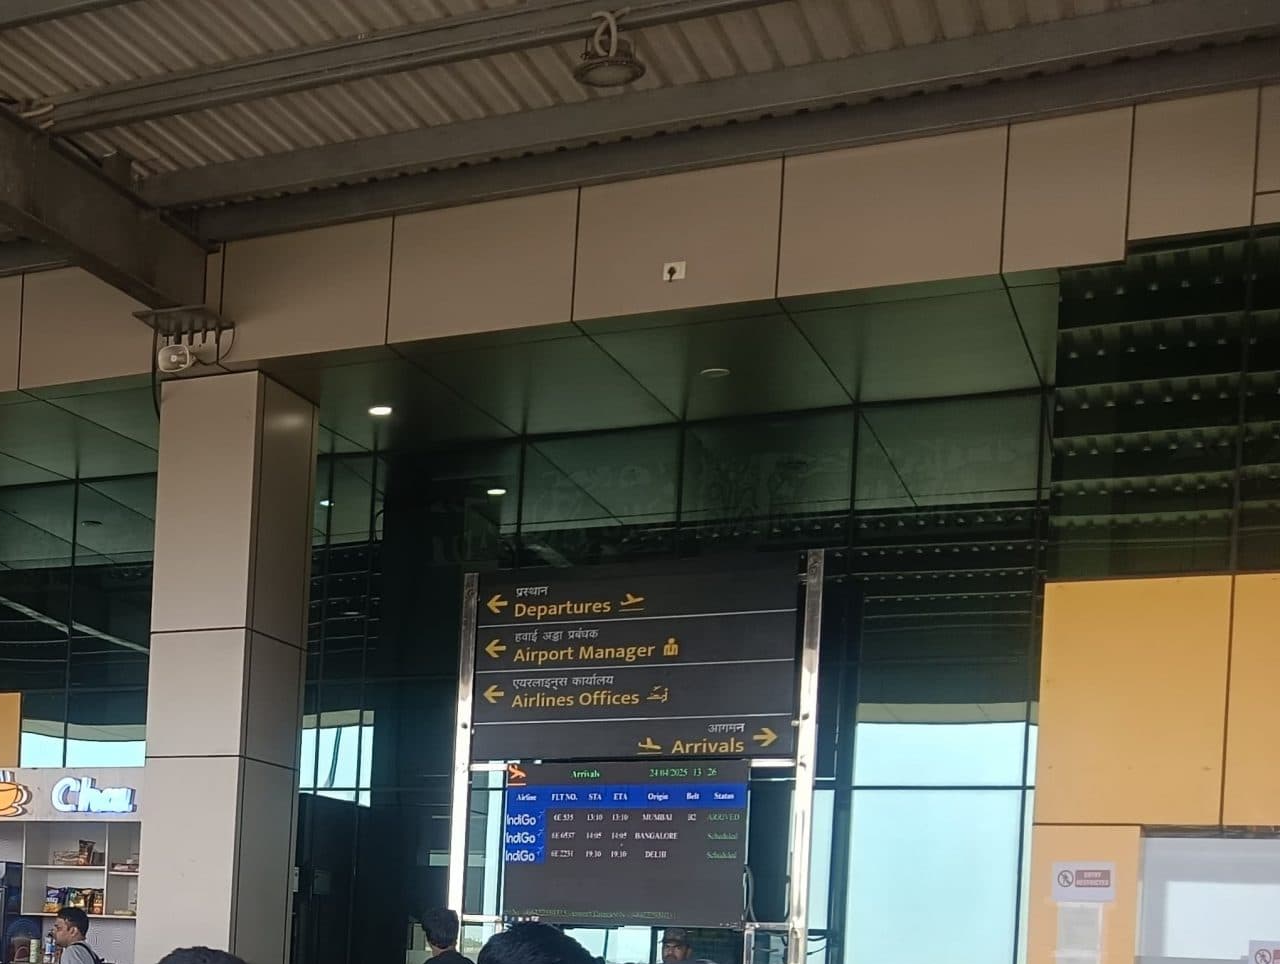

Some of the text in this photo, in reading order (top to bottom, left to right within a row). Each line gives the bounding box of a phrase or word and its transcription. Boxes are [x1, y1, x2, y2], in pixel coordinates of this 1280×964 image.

[516, 586, 548, 598] प्रस्थान
[515, 600, 611, 620] Departures
[515, 629, 538, 643] हवाई
[568, 627, 600, 640] प्रबंधक
[513, 643, 656, 665] Airport Manager
[572, 675, 614, 687] कार्यालय
[511, 691, 640, 708] Airlines Offices
[707, 722, 745, 734] आगमन
[671, 737, 745, 754] Arrivals
[571, 770, 600, 778] Arrivals
[613, 793, 628, 801] ETA
[647, 793, 669, 801] Origin
[686, 792, 700, 800] Belt
[713, 792, 735, 800] Status
[506, 814, 536, 825] IndiGo
[642, 813, 673, 821] MUMBAI
[505, 832, 535, 843] IndiGo
[635, 832, 678, 840] BANGALORE
[505, 850, 535, 861] IndiGo
[644, 850, 667, 858] DELHI
